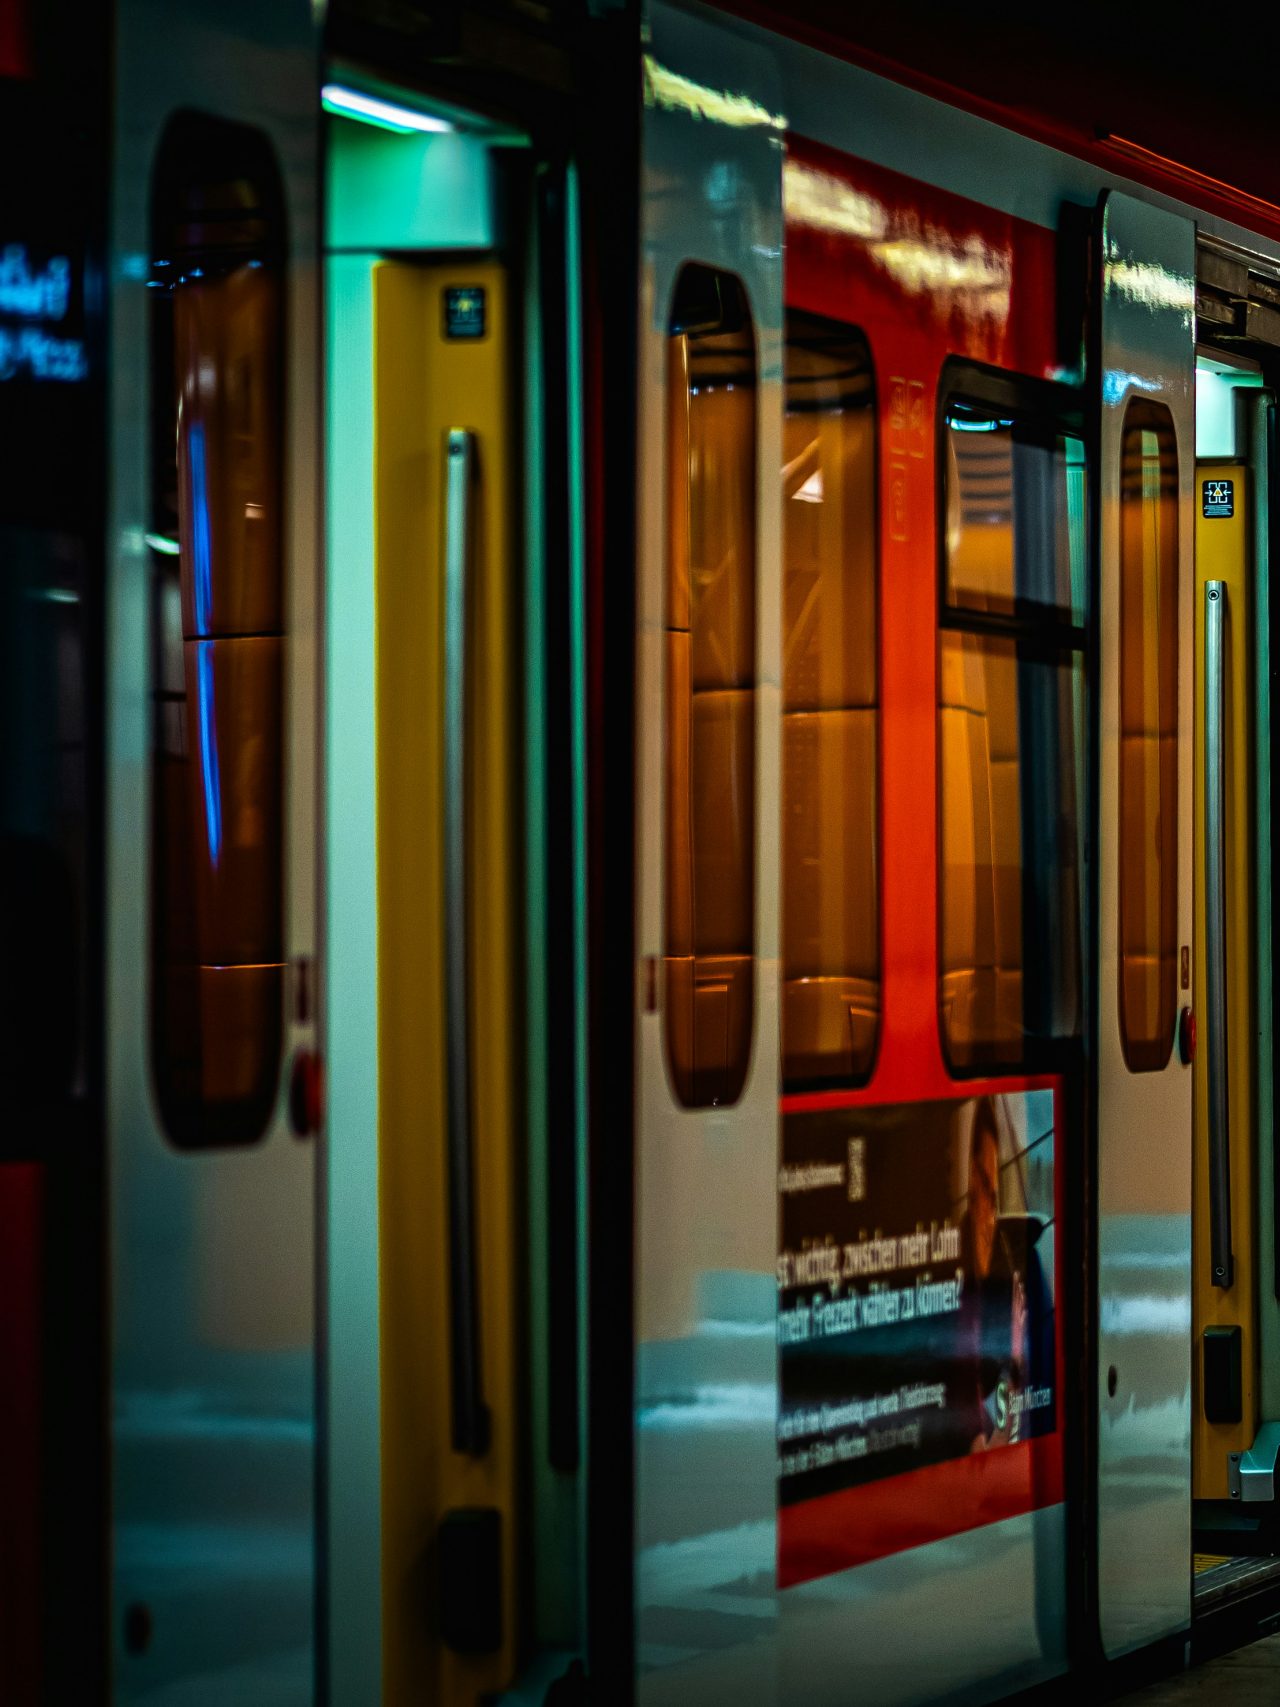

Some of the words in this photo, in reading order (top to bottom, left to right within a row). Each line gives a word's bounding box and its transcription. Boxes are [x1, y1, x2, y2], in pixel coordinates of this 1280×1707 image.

[843, 1228, 897, 1275] zwischen
[898, 1221, 929, 1268] mehr
[931, 1219, 961, 1263] Lohn
